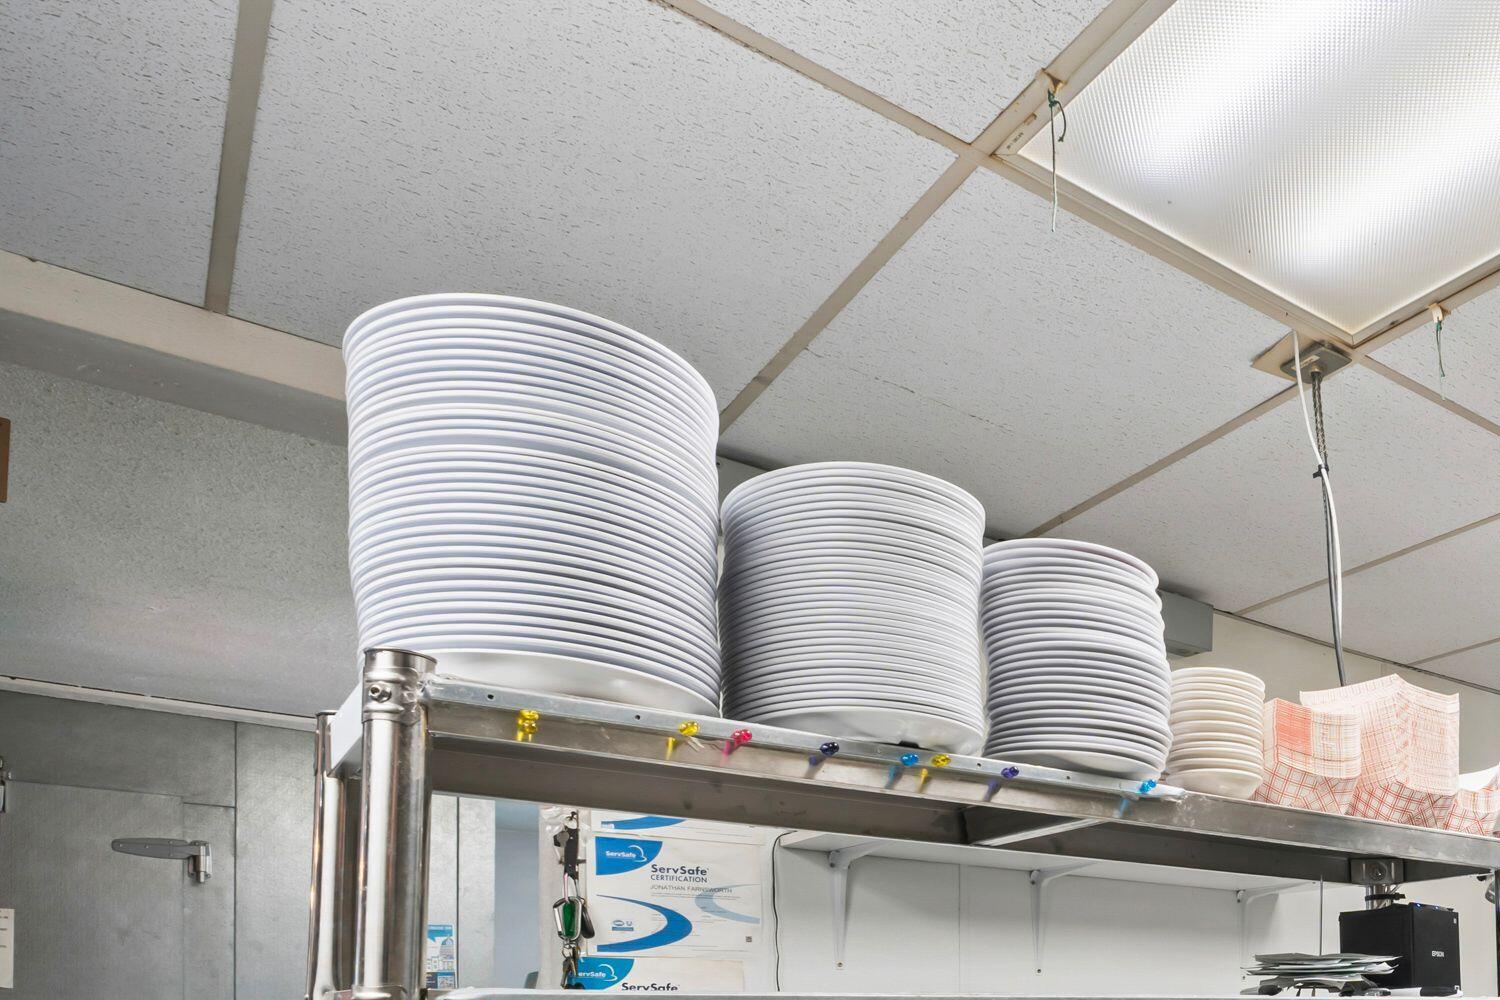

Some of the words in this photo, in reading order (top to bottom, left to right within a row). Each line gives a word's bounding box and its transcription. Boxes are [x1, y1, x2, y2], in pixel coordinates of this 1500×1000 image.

[605, 850, 637, 859] ServSafe
[651, 864, 708, 876] ServSafe
[651, 874, 708, 884] CERTIFICATION
[578, 971, 607, 979] ervSafe
